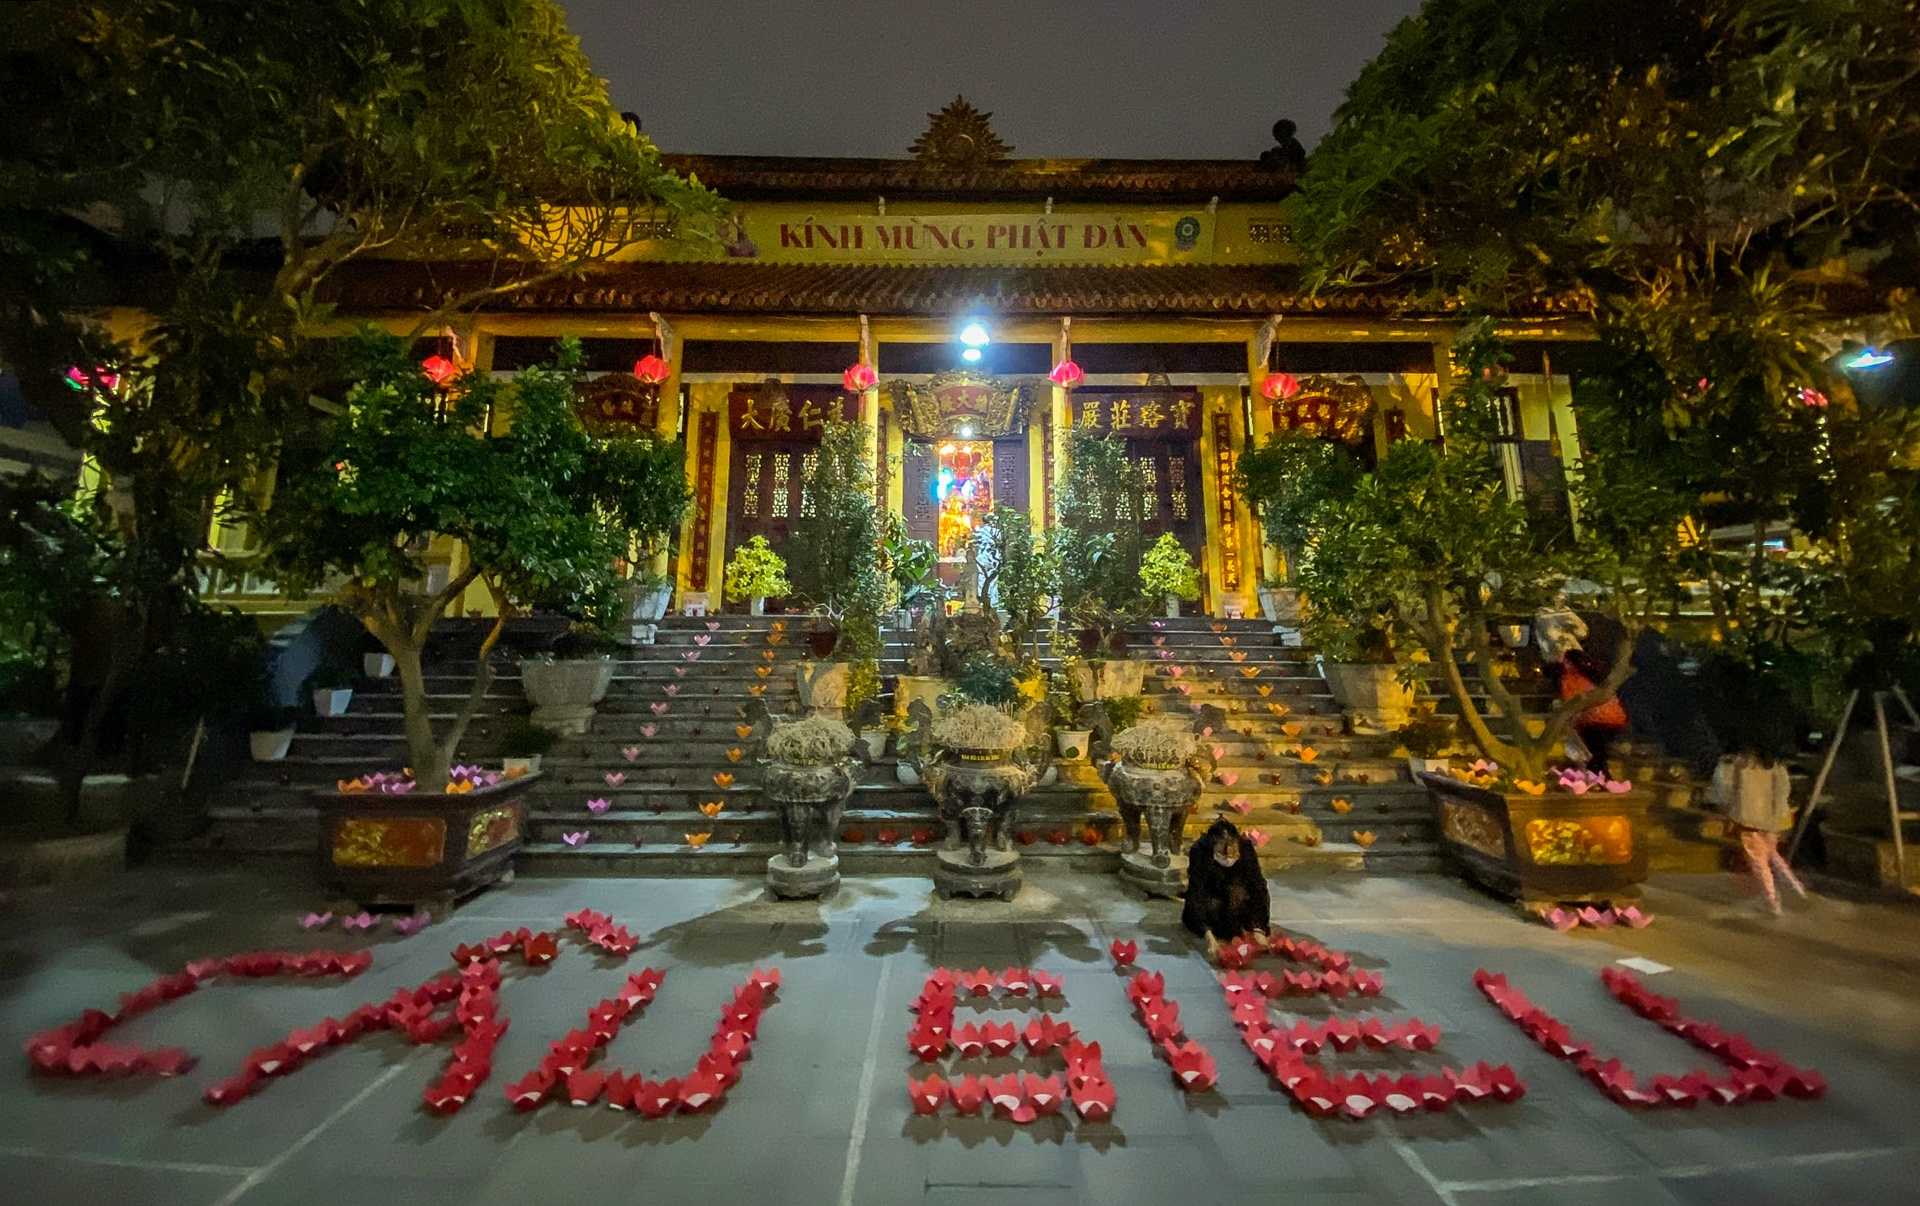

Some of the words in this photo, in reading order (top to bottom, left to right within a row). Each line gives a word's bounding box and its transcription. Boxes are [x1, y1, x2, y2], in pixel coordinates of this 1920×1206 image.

[781, 216, 864, 249] KÍNH
[876, 217, 975, 250] MỪNG
[987, 218, 1073, 257] PHẬT
[1084, 215, 1149, 249] ĐẢN
